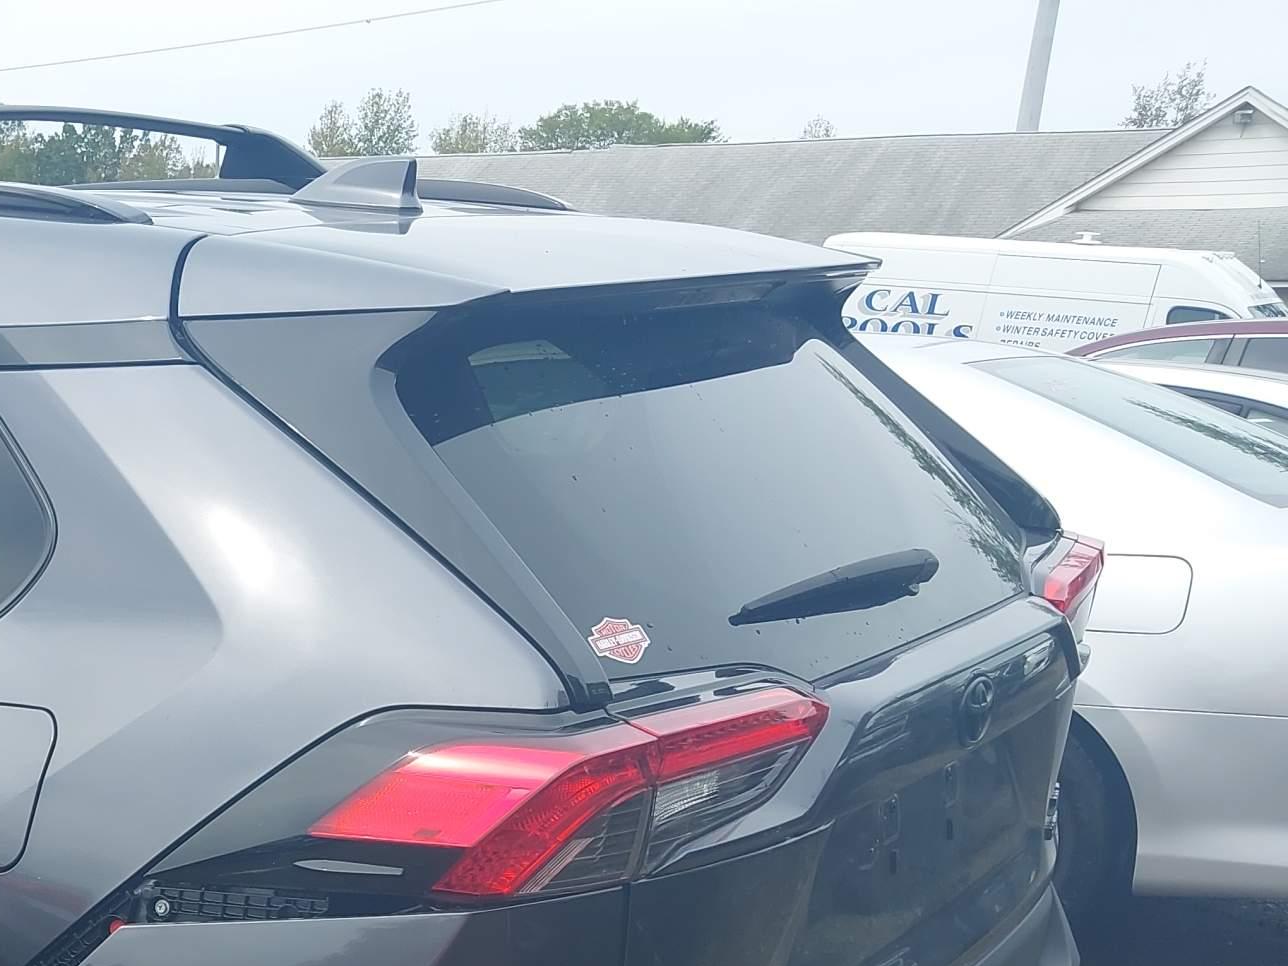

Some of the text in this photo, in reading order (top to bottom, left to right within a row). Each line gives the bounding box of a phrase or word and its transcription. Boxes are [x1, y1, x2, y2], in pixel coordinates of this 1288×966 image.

[865, 289, 950, 316] CAL
[1006, 310, 1118, 327] WEEKLY MAINTENANCE
[1002, 324, 1041, 336] WINTER
[1041, 327, 1080, 339] SAFETY
